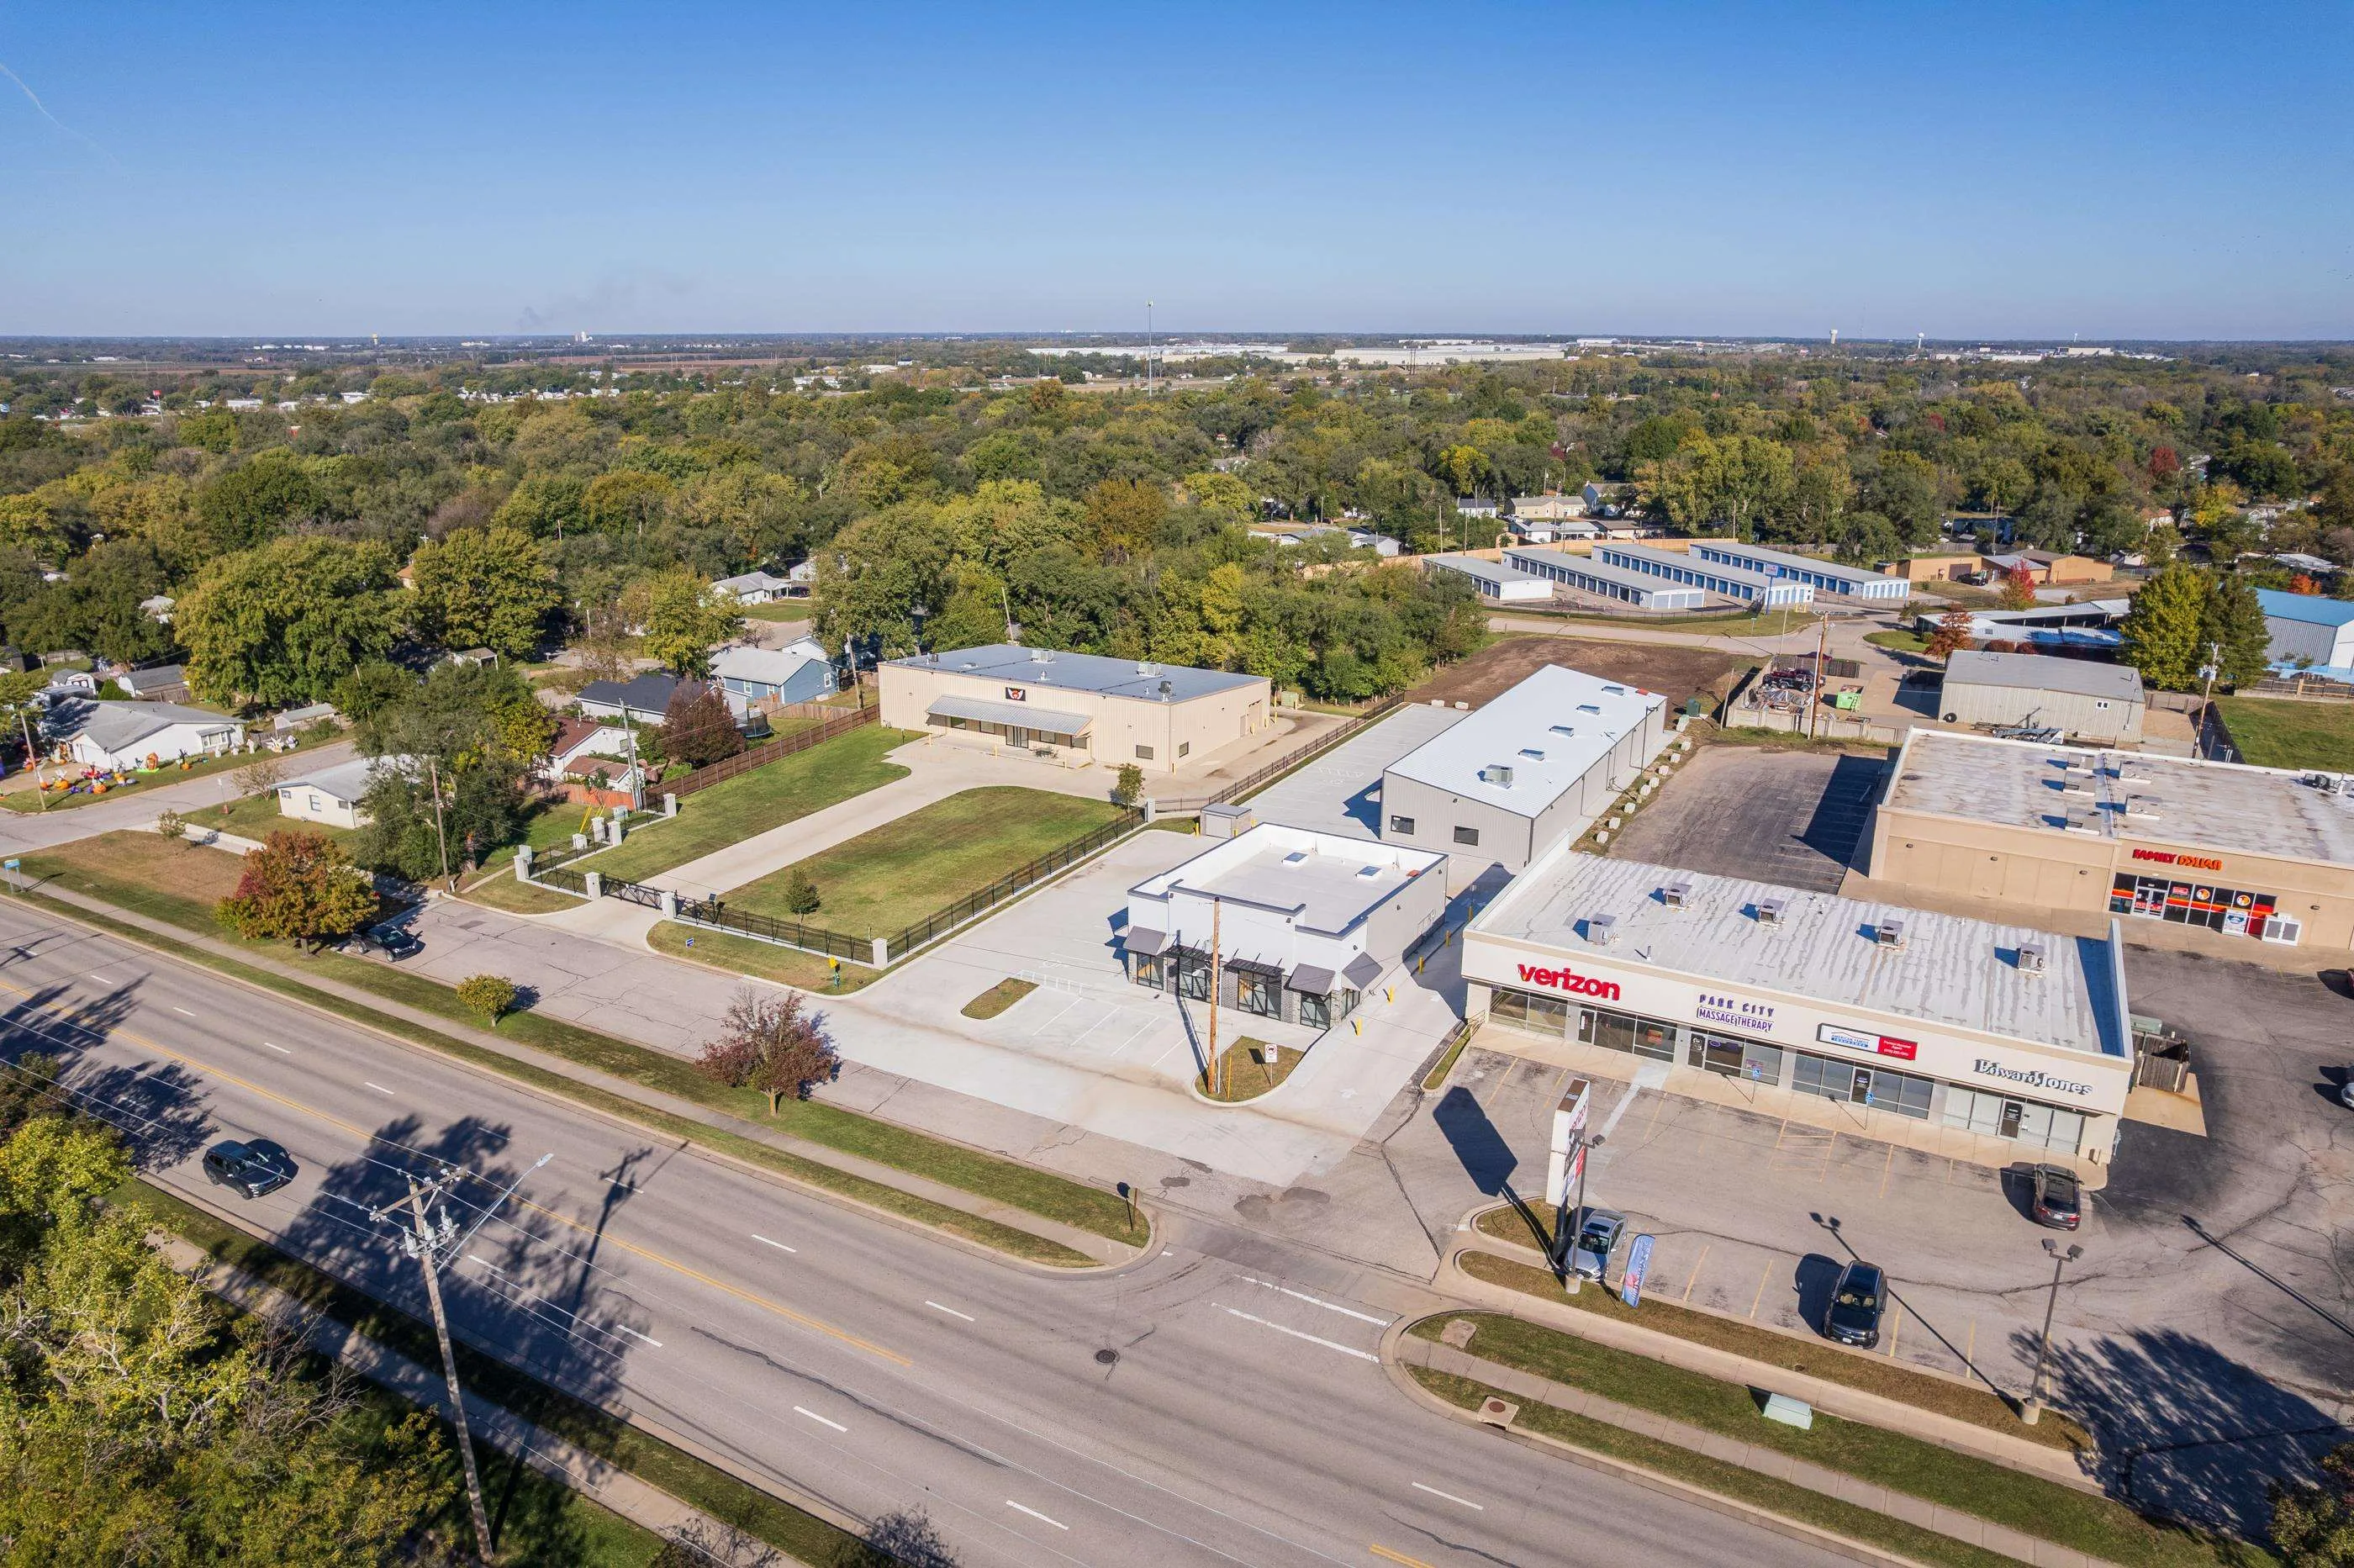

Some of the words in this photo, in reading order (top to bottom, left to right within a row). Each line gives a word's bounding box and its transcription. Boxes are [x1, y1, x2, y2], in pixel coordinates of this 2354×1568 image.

[2132, 849, 2177, 863] FAMILY
[2177, 855, 2222, 870] DOLLAR
[1517, 964, 1620, 1000] verizon
[1699, 994, 1734, 1009] PARK
[1742, 1003, 1774, 1016] CITY
[1698, 1008, 1735, 1024] MASSAGE
[1737, 1016, 1773, 1031] THERAPY
[1973, 1059, 2040, 1086] Edward
[2039, 1072, 2093, 1095] Jones
